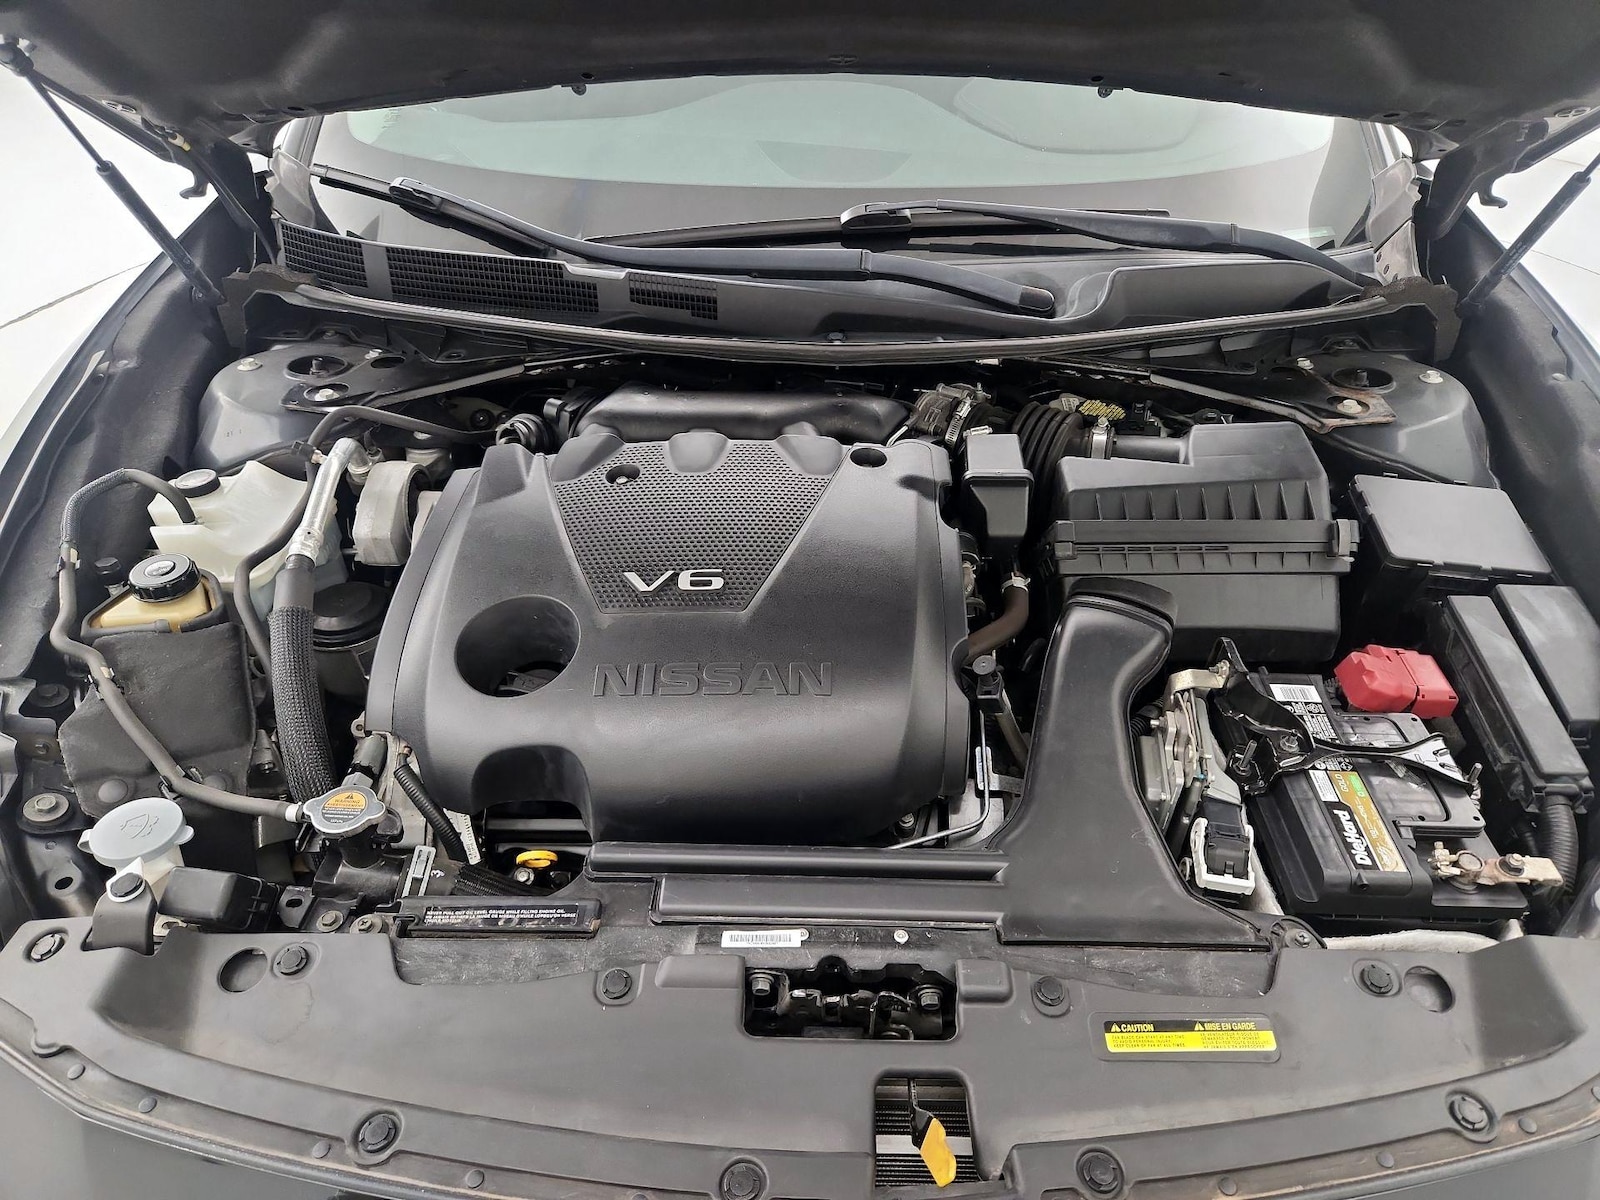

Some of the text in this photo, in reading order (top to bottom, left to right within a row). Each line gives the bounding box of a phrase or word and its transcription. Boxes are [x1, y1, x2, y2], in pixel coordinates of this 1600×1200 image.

[623, 569, 725, 592] V6
[593, 662, 832, 696] NISSAN
[1332, 809, 1373, 866] DieHard
[1121, 1024, 1155, 1032] CAUTION
